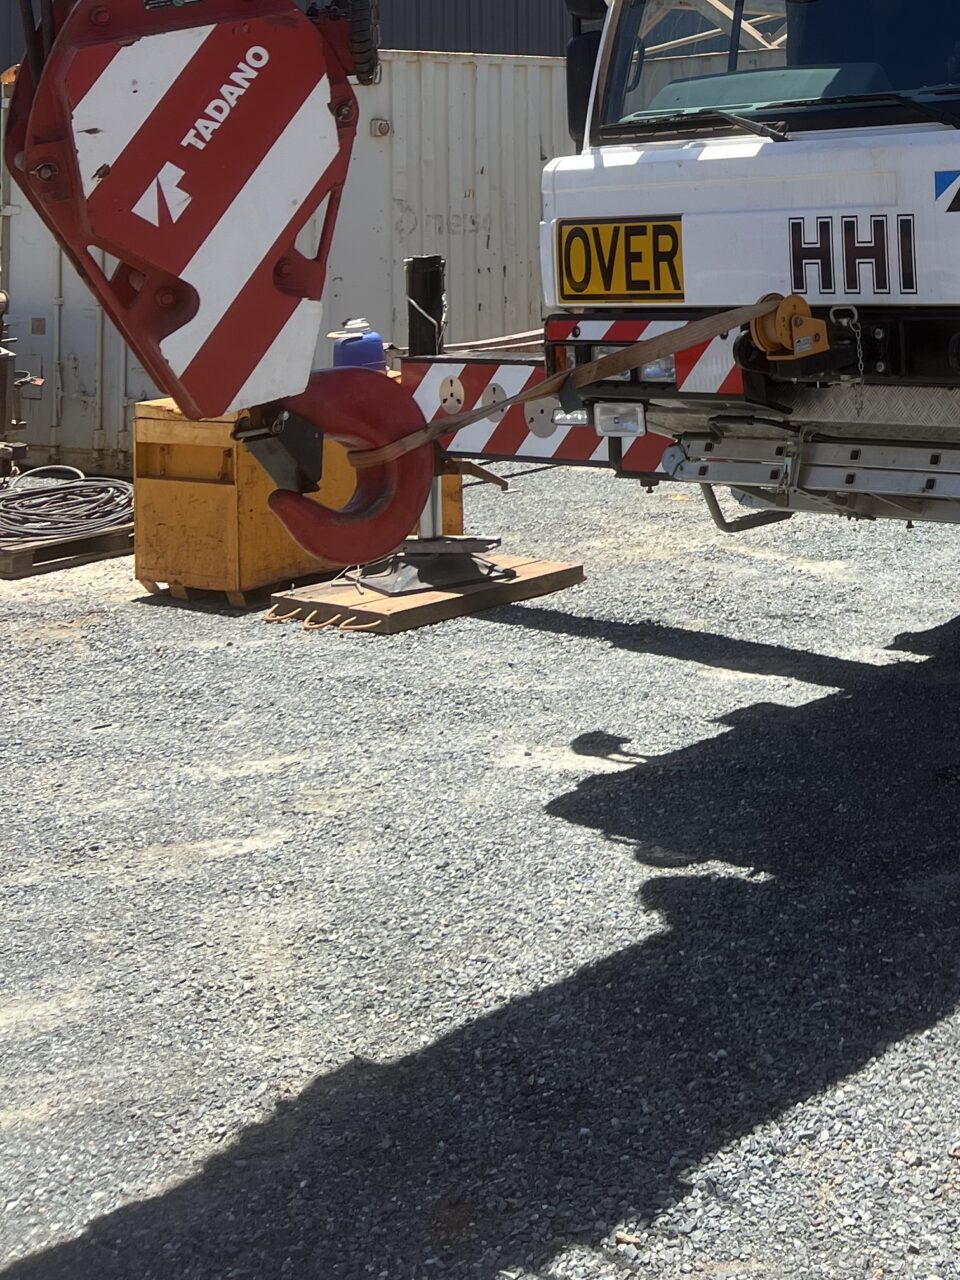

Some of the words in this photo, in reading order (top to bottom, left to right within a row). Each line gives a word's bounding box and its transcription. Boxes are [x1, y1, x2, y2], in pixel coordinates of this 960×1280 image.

[180, 46, 270, 151] TADANO
[564, 224, 682, 293] OVER
[788, 214, 918, 295] HHI
